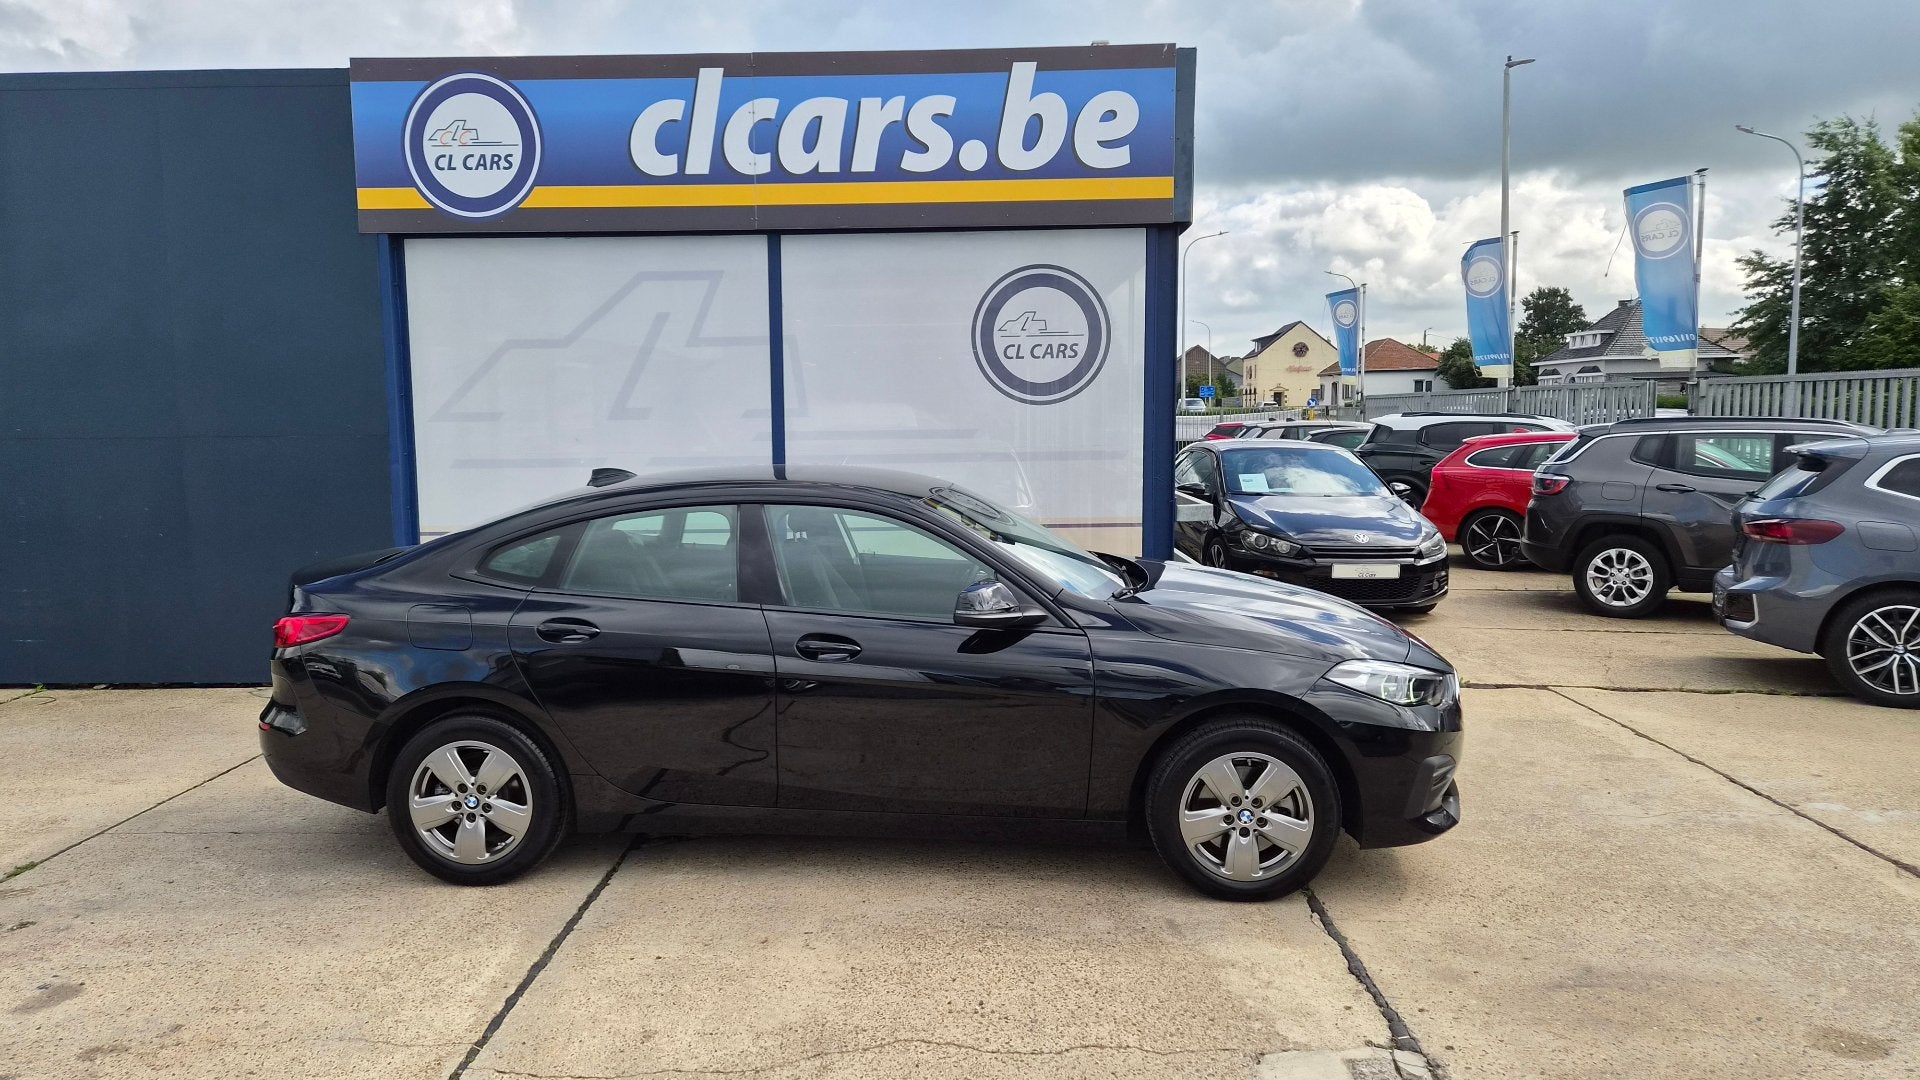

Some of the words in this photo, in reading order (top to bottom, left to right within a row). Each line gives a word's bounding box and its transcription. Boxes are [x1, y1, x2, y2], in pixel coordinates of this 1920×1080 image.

[629, 61, 1140, 177] clcars.be
[434, 153, 457, 171] CL
[462, 153, 514, 171] CARS
[1003, 343, 1025, 359] CL
[1029, 342, 1079, 359] CARS
